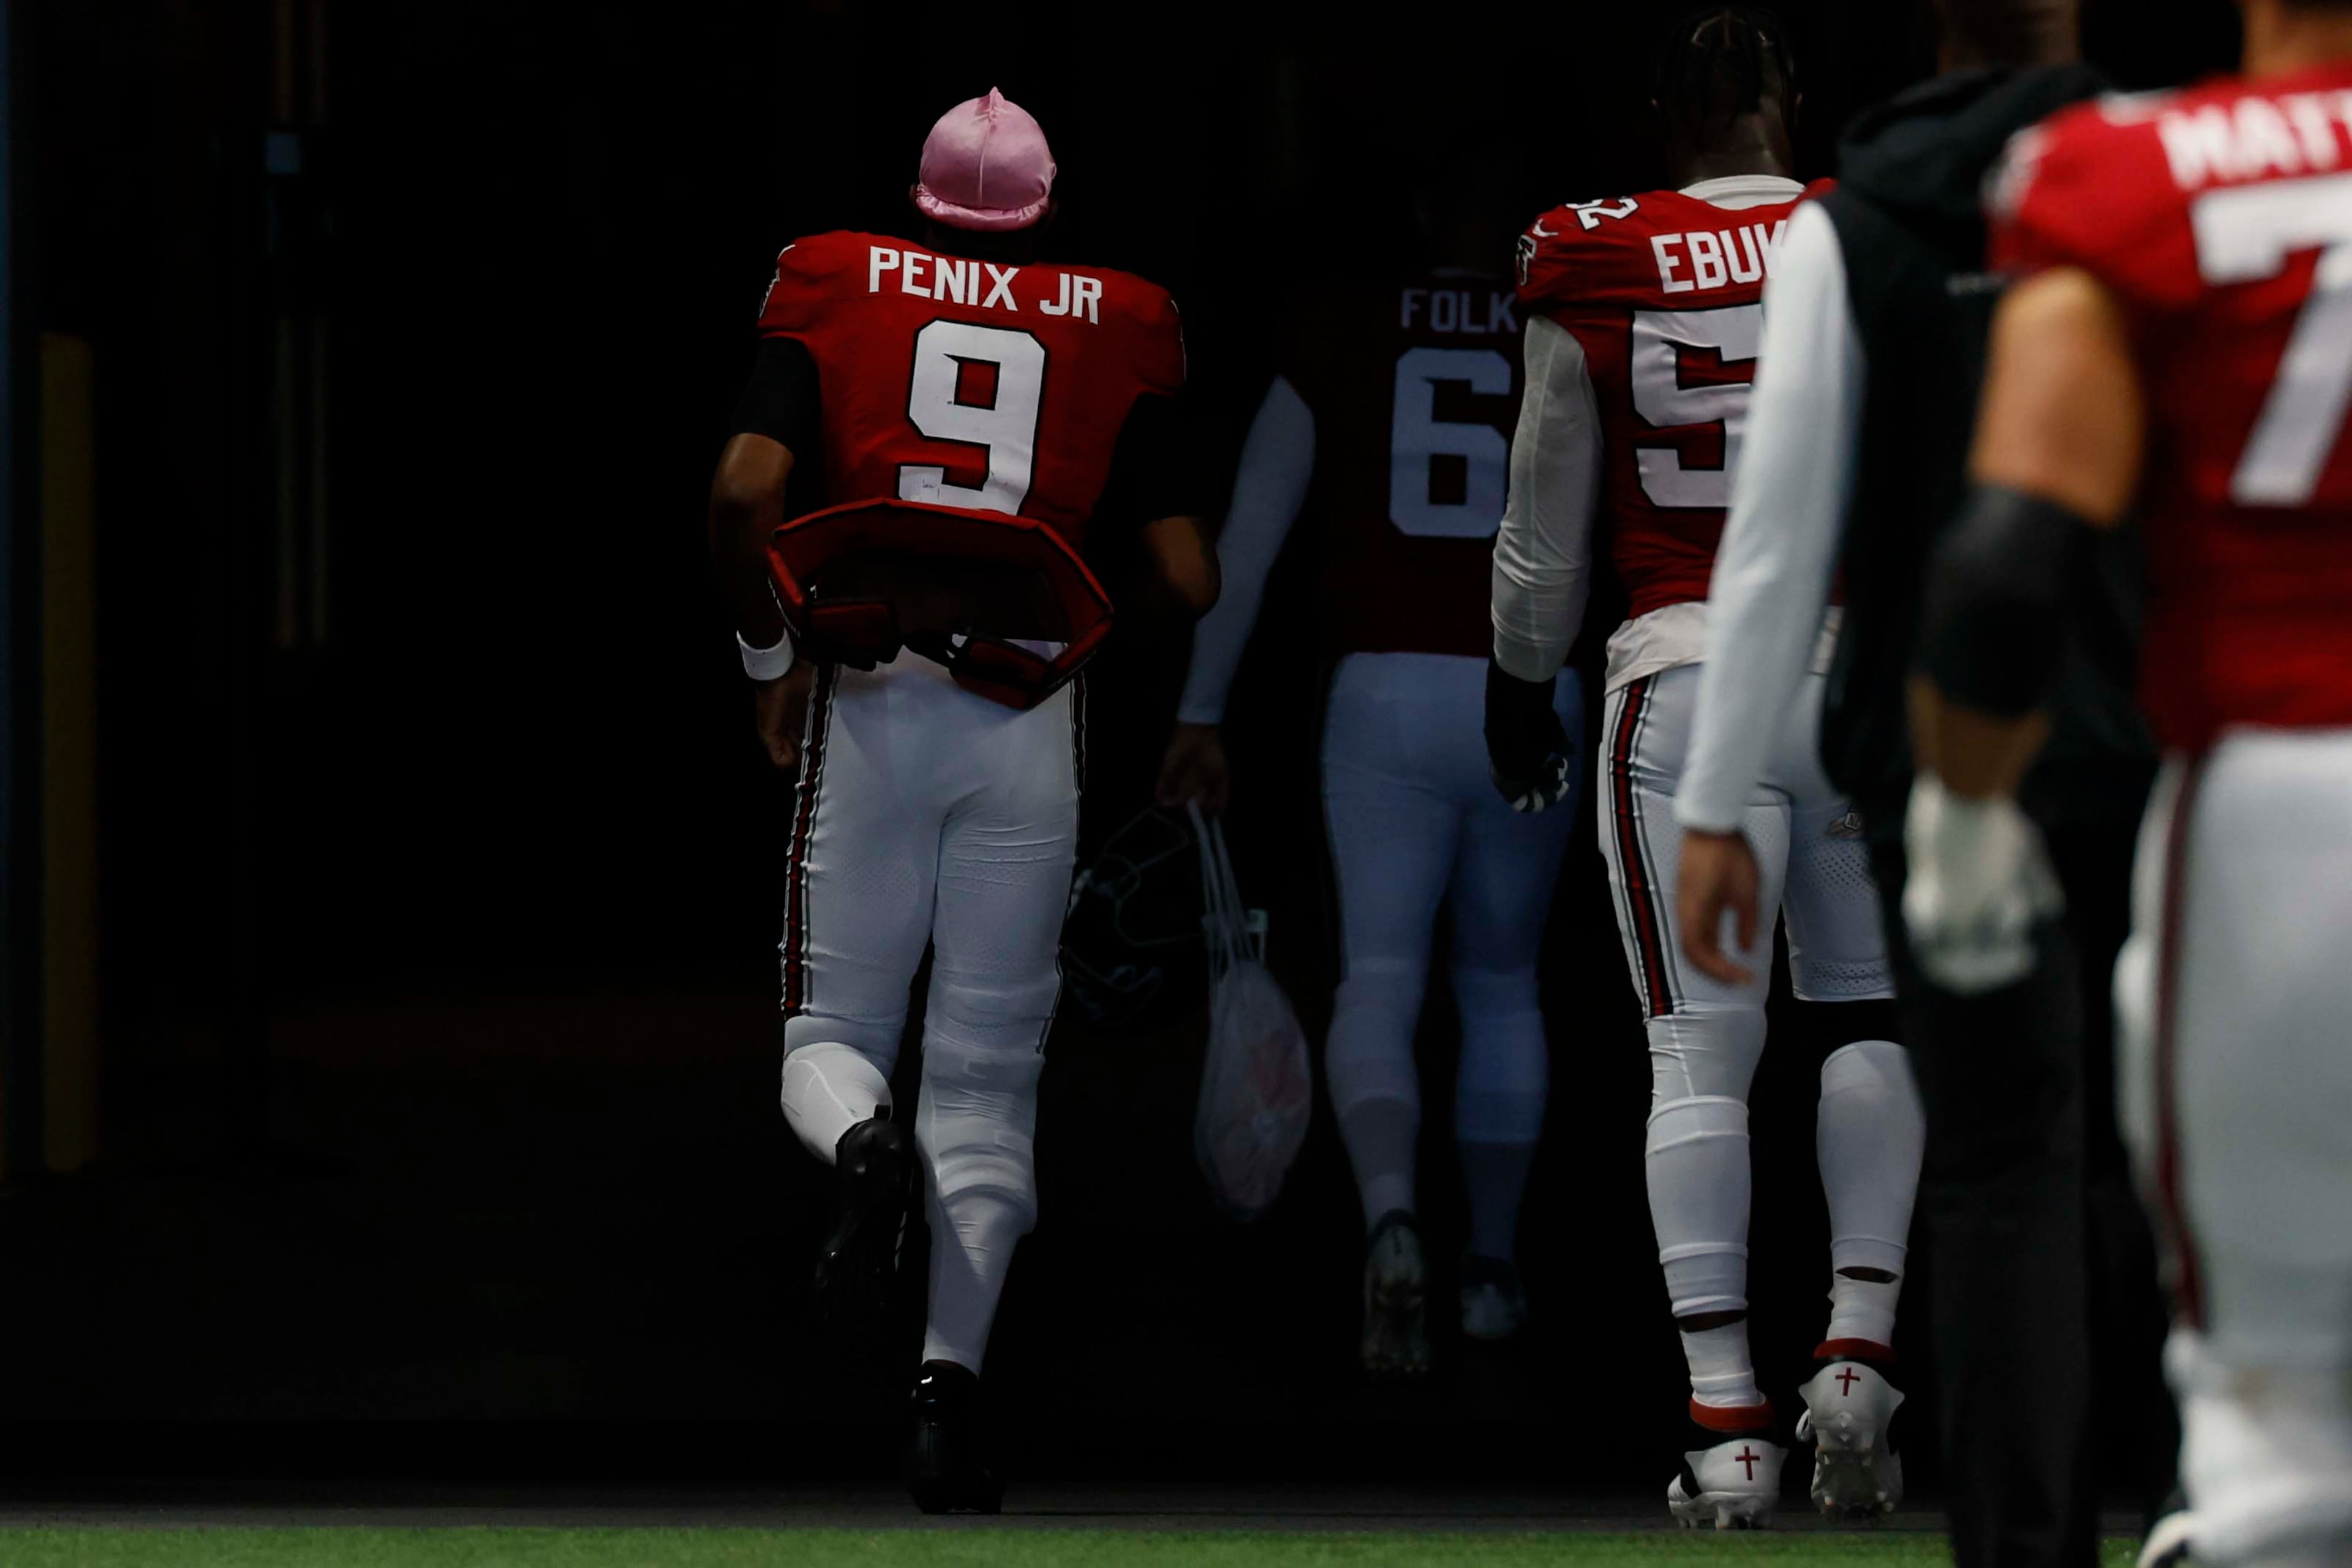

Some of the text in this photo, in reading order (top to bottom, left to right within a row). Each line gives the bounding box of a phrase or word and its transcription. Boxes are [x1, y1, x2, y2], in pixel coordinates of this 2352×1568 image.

[869, 246, 1102, 325] PENIX JR
[1400, 287, 1519, 334] FOLK
[899, 319, 1045, 516] 9
[1388, 345, 1512, 539] 6
